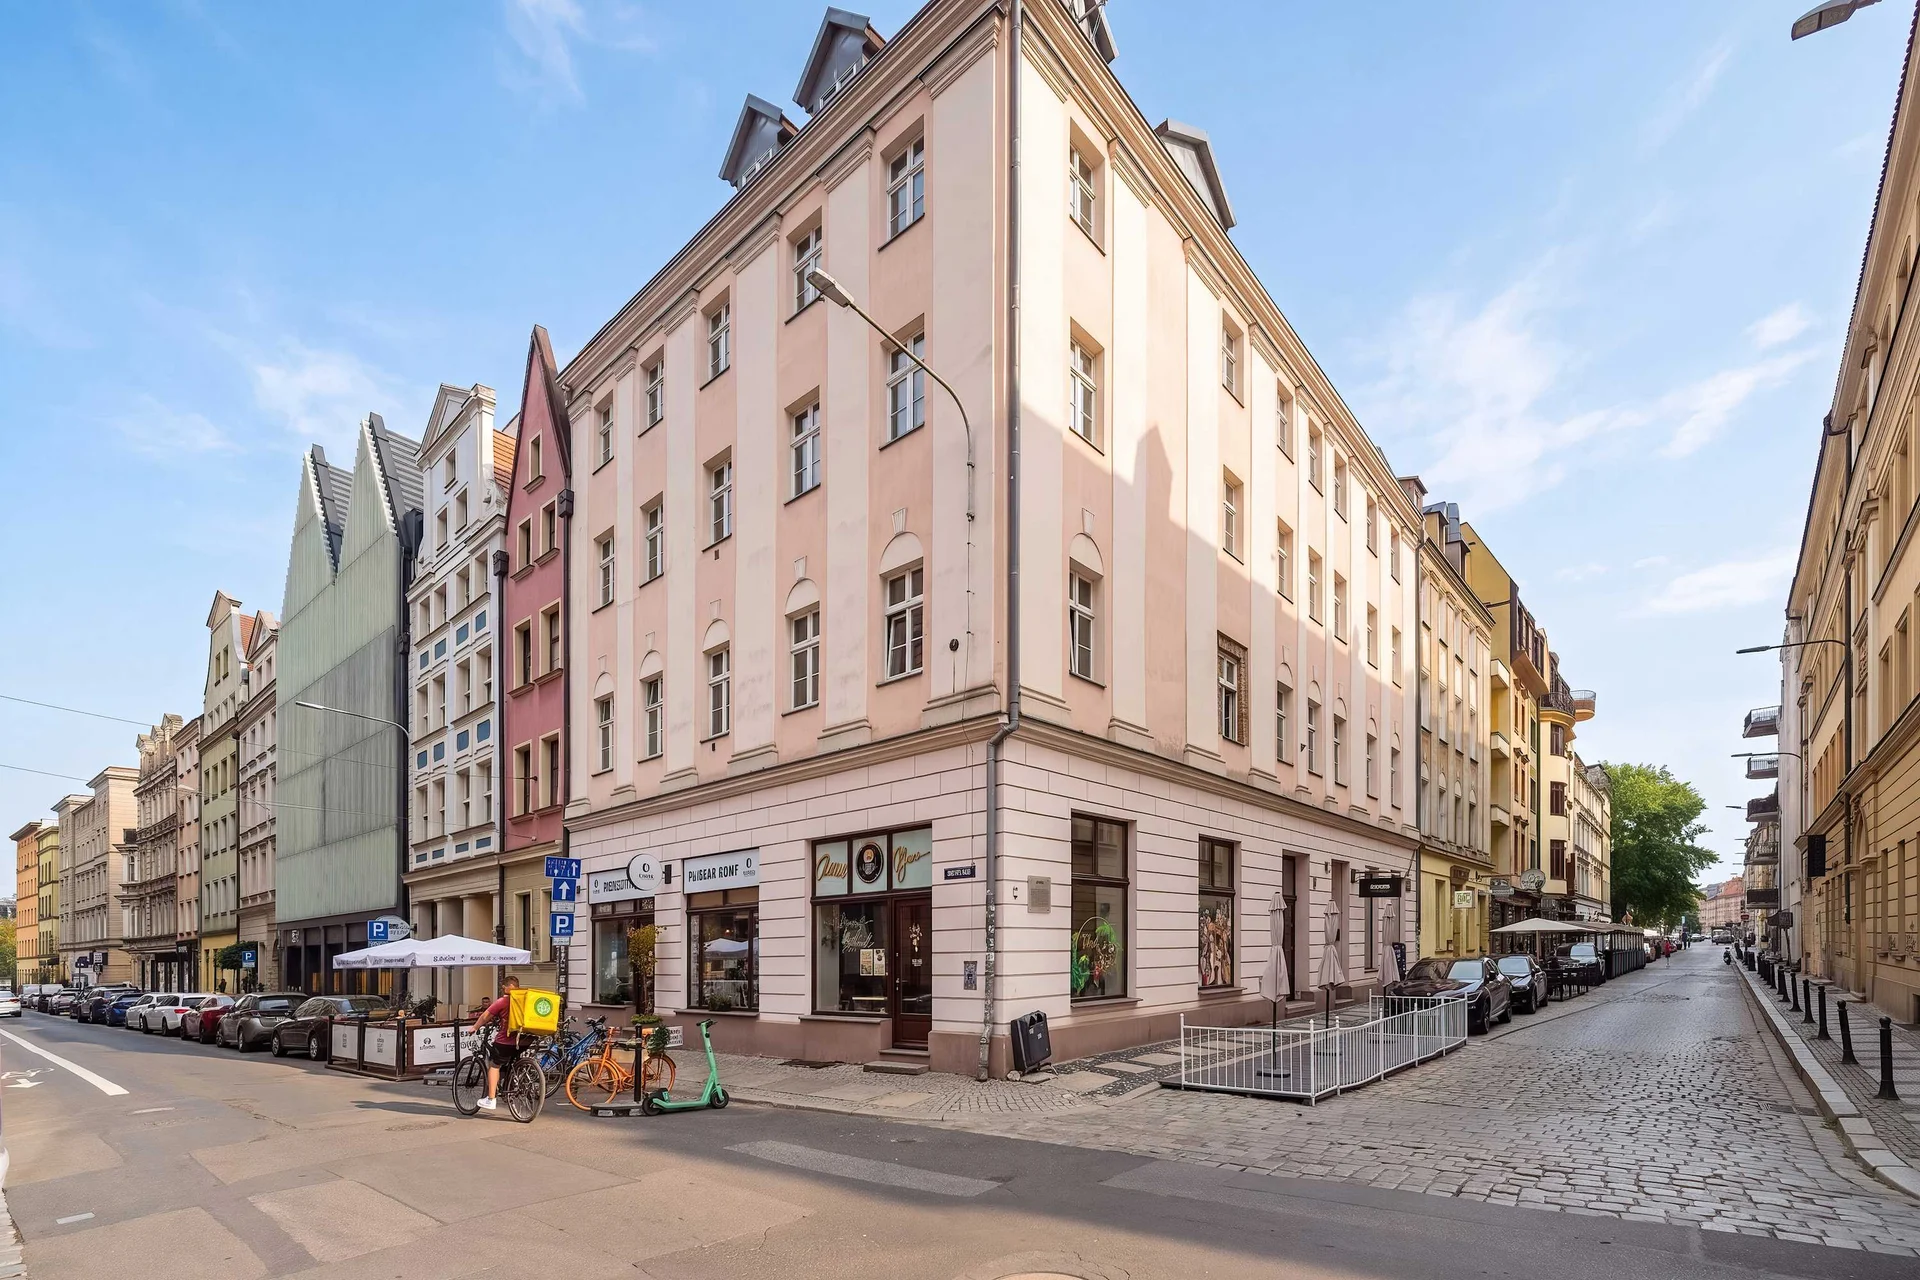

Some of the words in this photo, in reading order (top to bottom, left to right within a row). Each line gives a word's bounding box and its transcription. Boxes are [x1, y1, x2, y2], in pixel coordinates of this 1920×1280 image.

[373, 922, 384, 937] P
[556, 915, 569, 934] P
[245, 952, 252, 960] P
